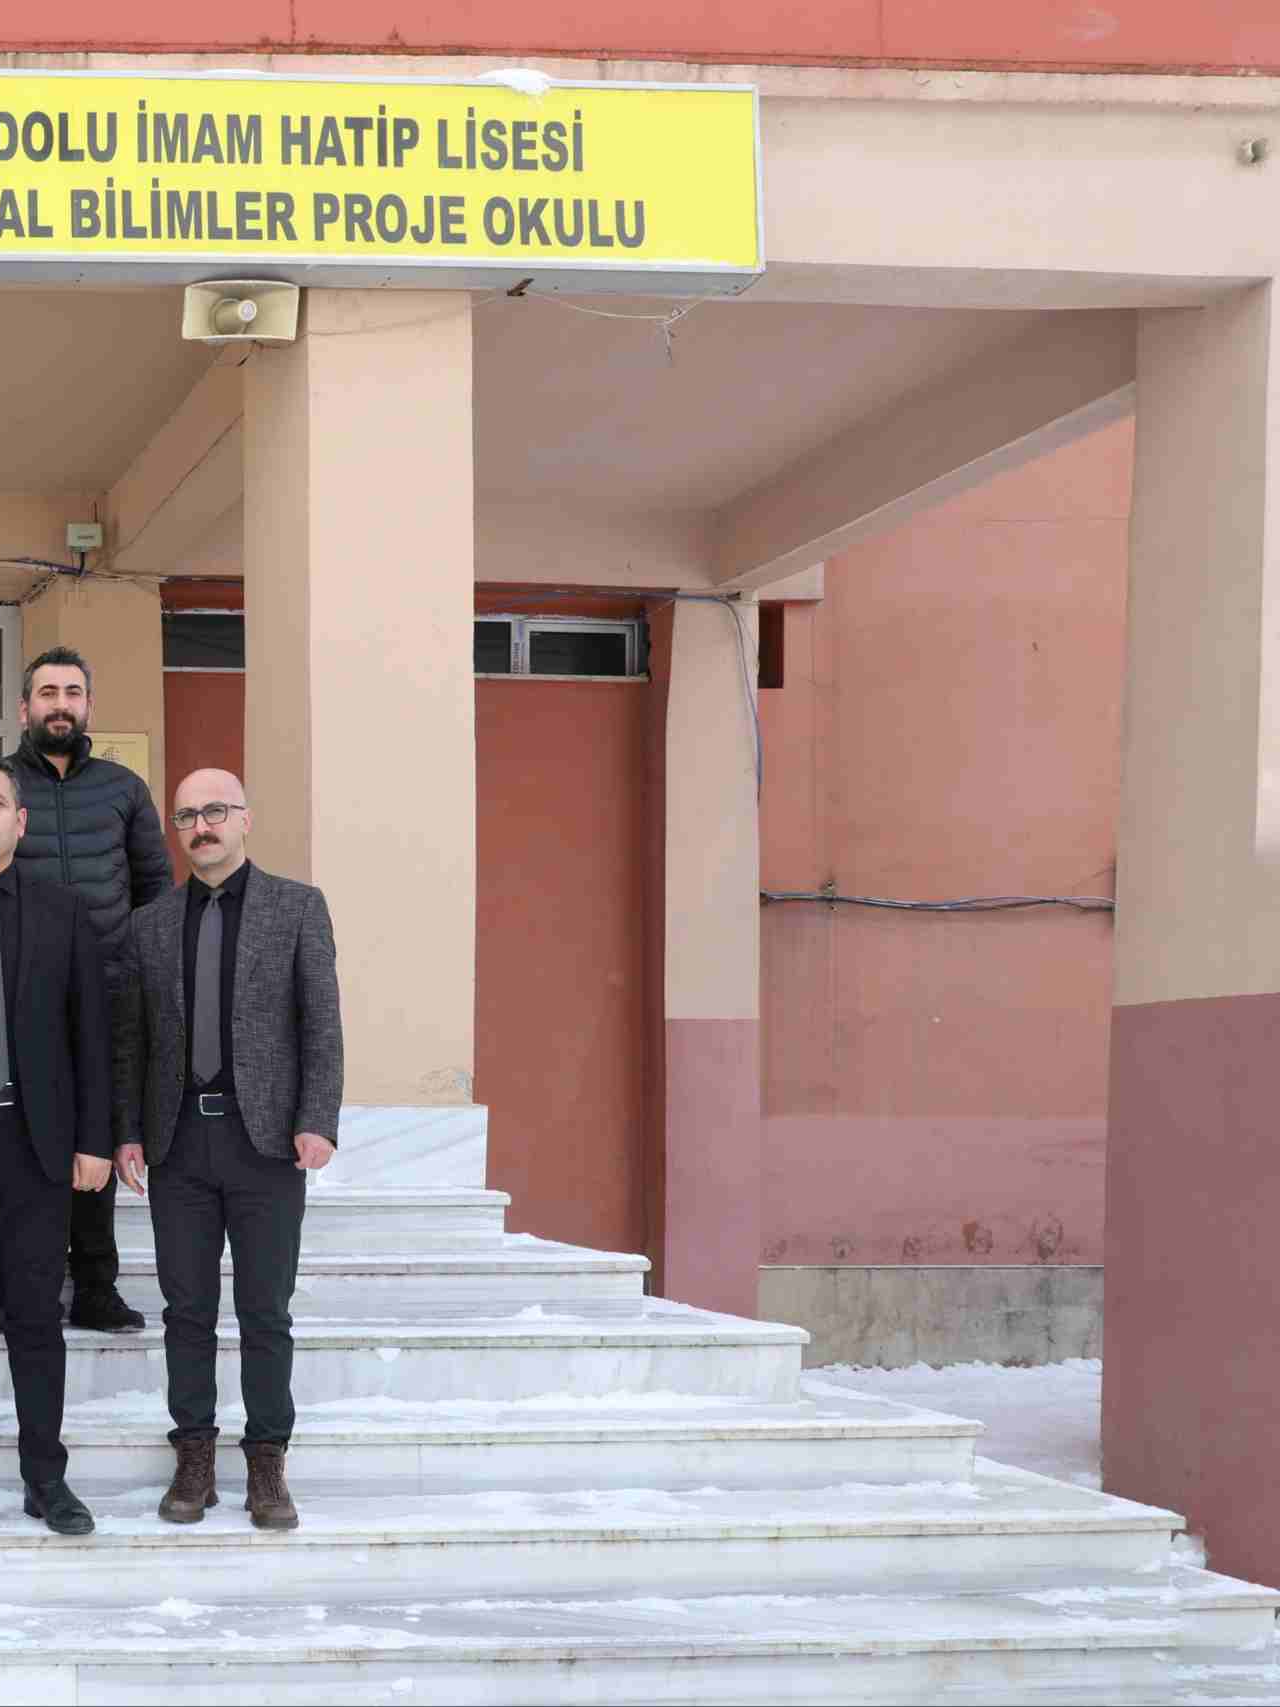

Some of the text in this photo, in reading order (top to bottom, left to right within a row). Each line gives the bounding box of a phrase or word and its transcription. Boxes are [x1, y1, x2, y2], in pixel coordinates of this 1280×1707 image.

[137, 100, 263, 165] İMAM
[280, 104, 420, 169] HATİP
[437, 107, 584, 173] LİSESİ
[70, 177, 299, 242] BİLİMLER
[313, 191, 469, 244] PROJE
[482, 195, 647, 249] OKULU
